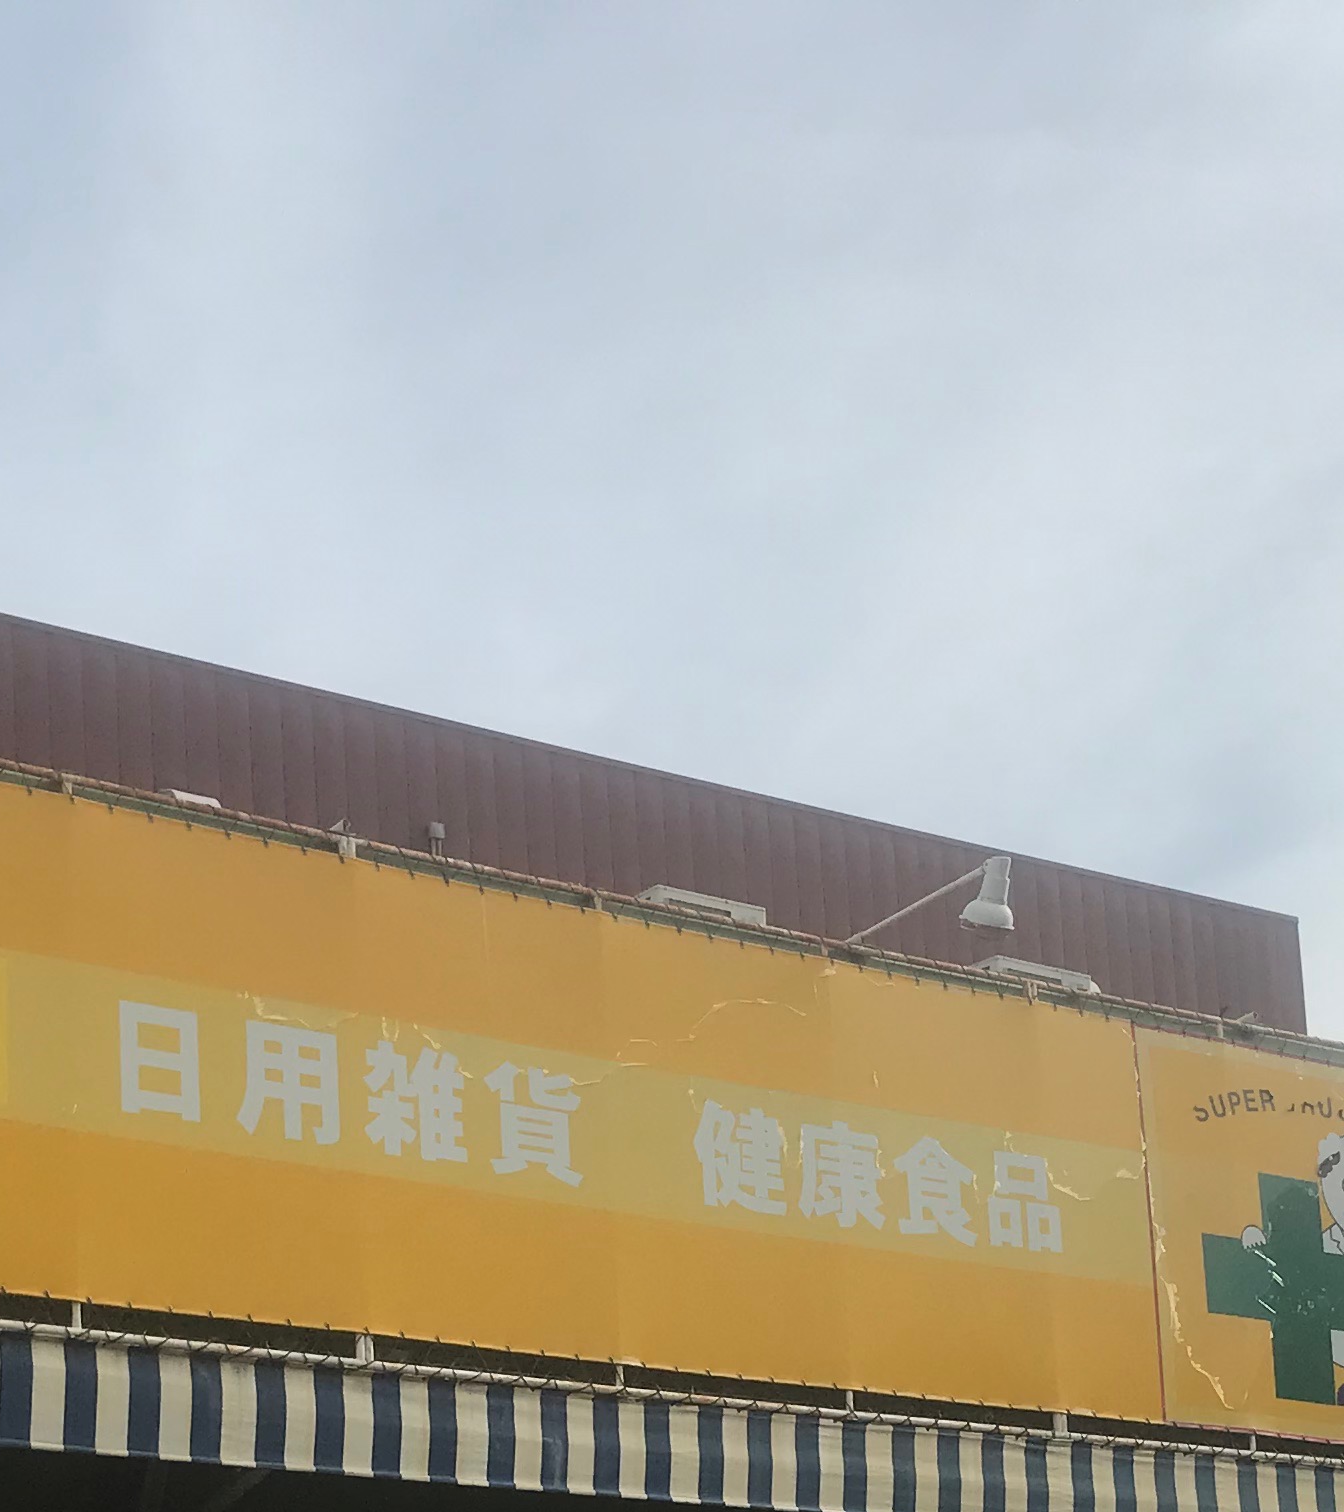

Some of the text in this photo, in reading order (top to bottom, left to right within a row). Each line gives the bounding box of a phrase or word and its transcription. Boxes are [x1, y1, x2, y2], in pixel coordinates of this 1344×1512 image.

[117, 999, 1067, 1255] 日用雑貨 健康食品
[1193, 1089, 1277, 1123] SUPER
